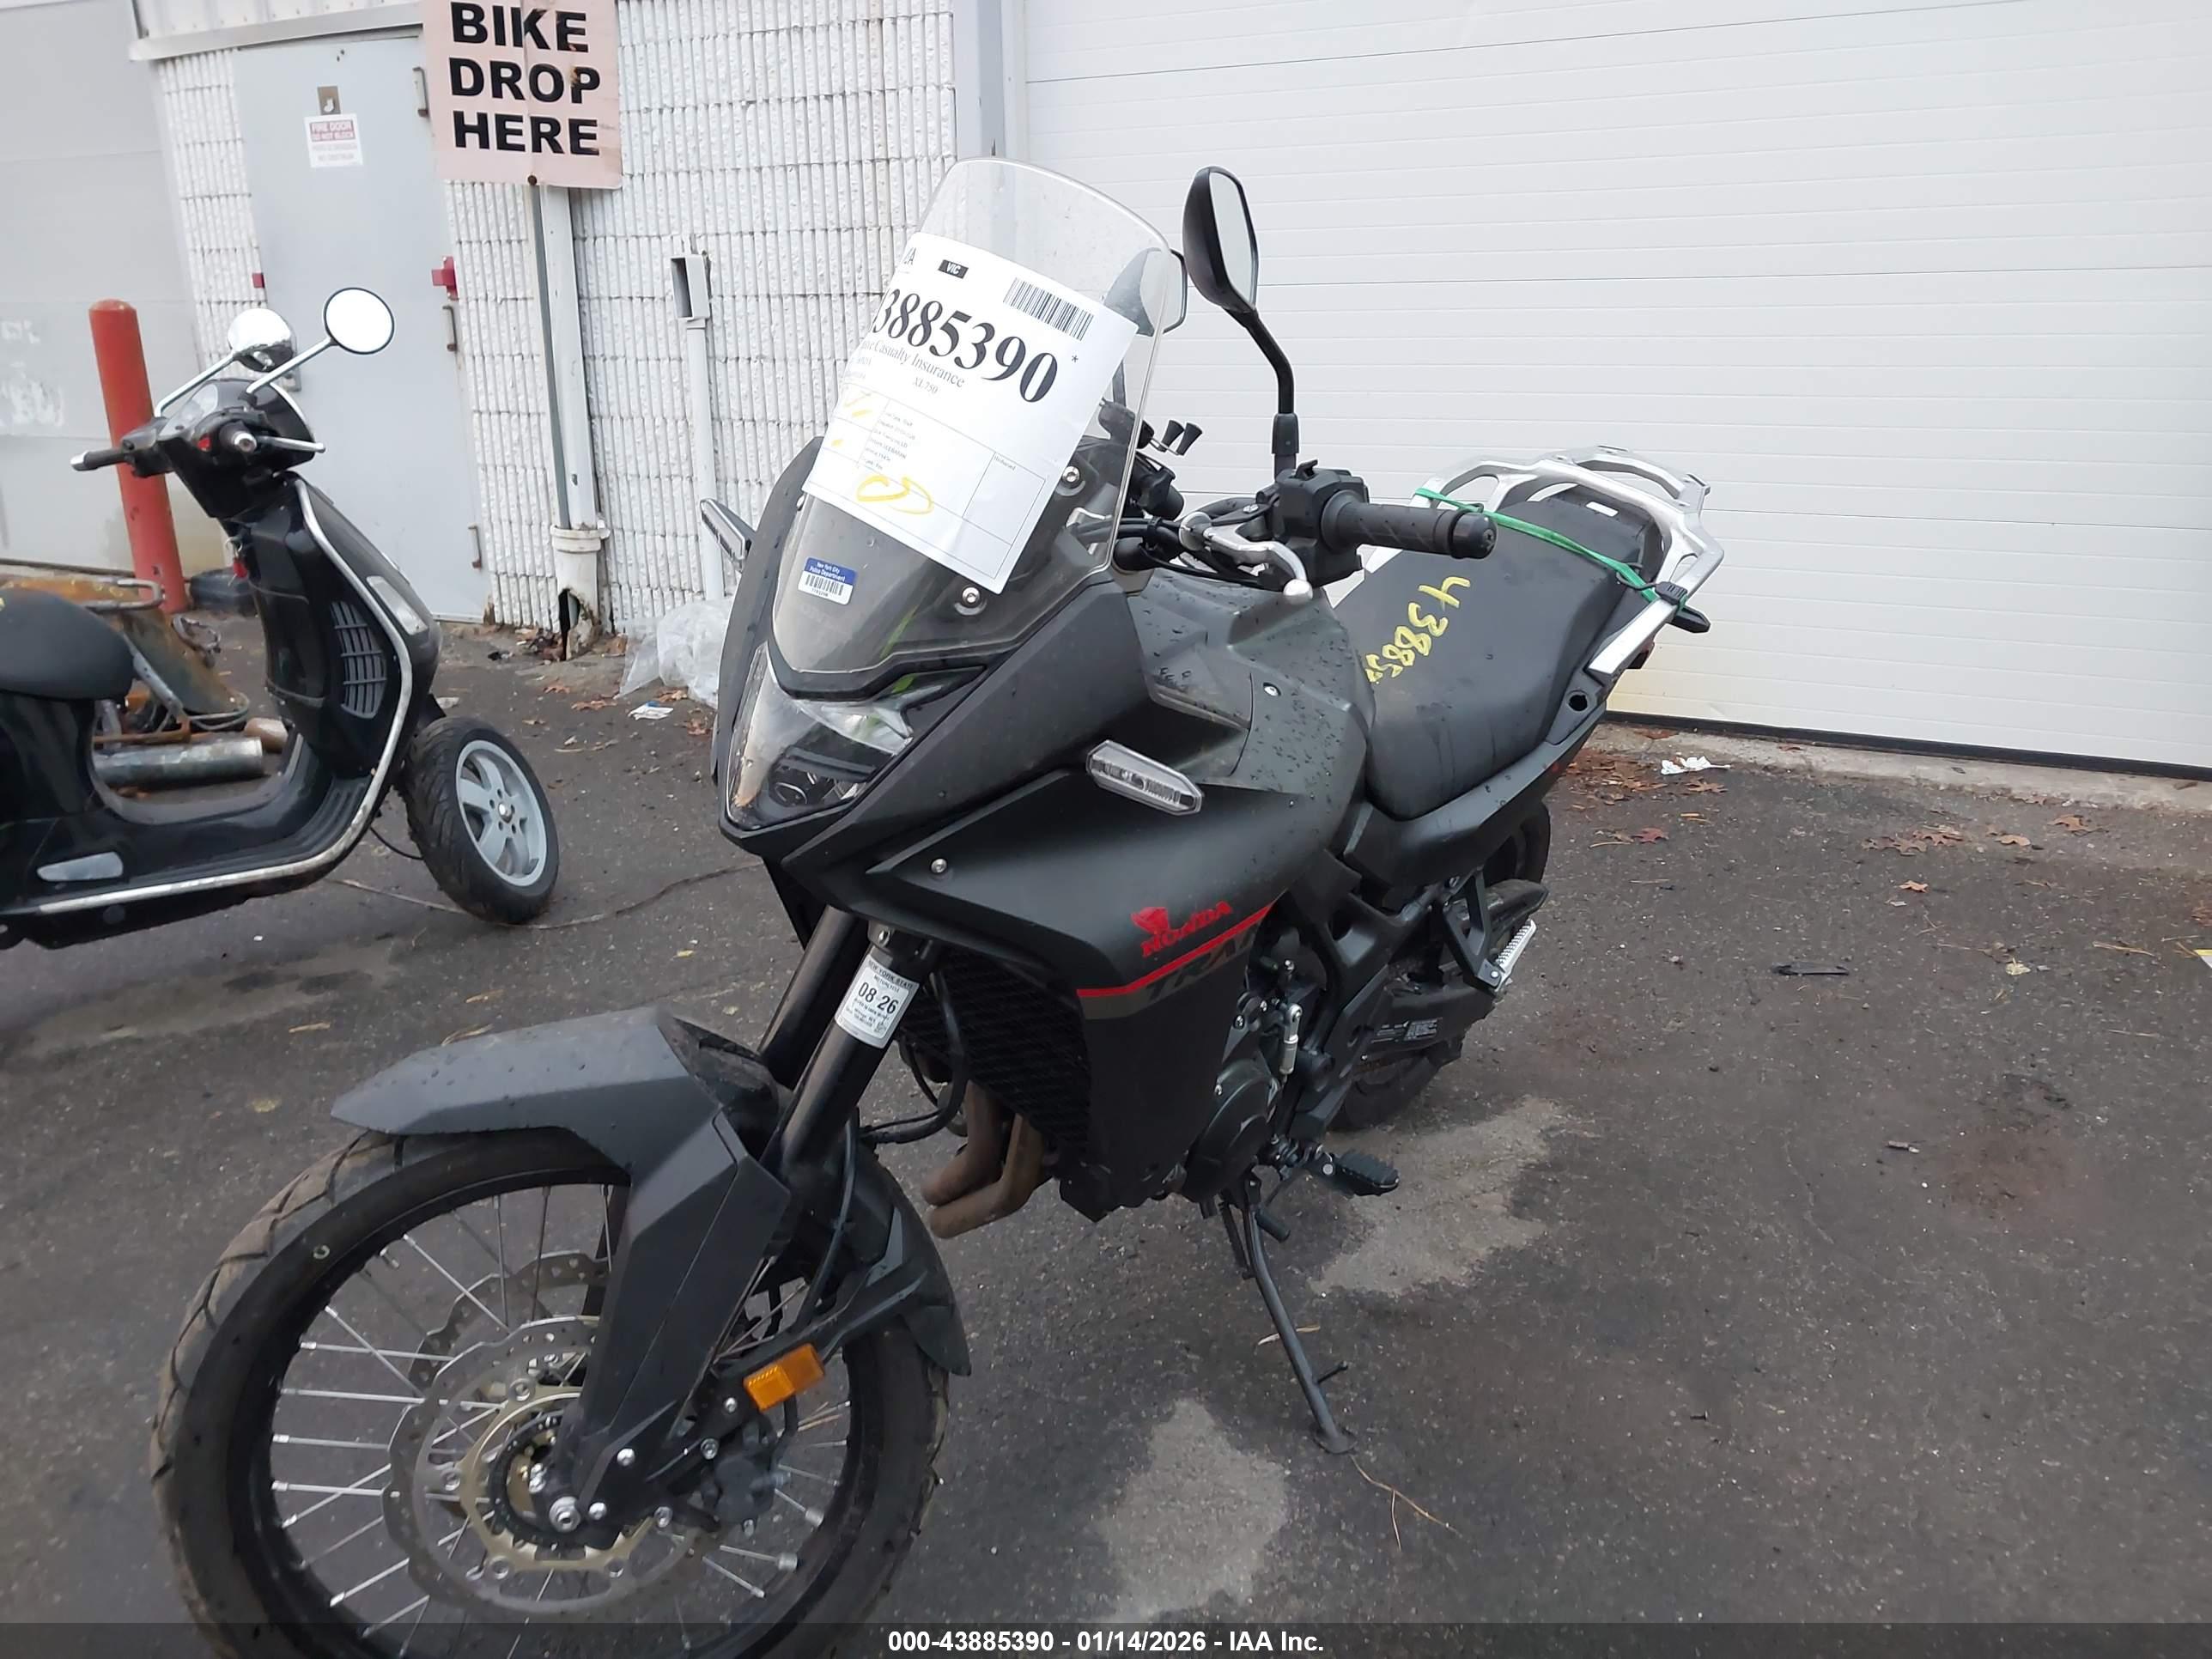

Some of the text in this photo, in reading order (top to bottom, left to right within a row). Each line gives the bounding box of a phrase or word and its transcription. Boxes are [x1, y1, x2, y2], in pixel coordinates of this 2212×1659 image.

[451, 2, 589, 52] BIKE
[449, 57, 600, 104] DROP
[453, 111, 600, 156] HERE
[911, 353, 965, 388] Insurance
[858, 982, 878, 1003] 08
[877, 995, 899, 1014] 26
